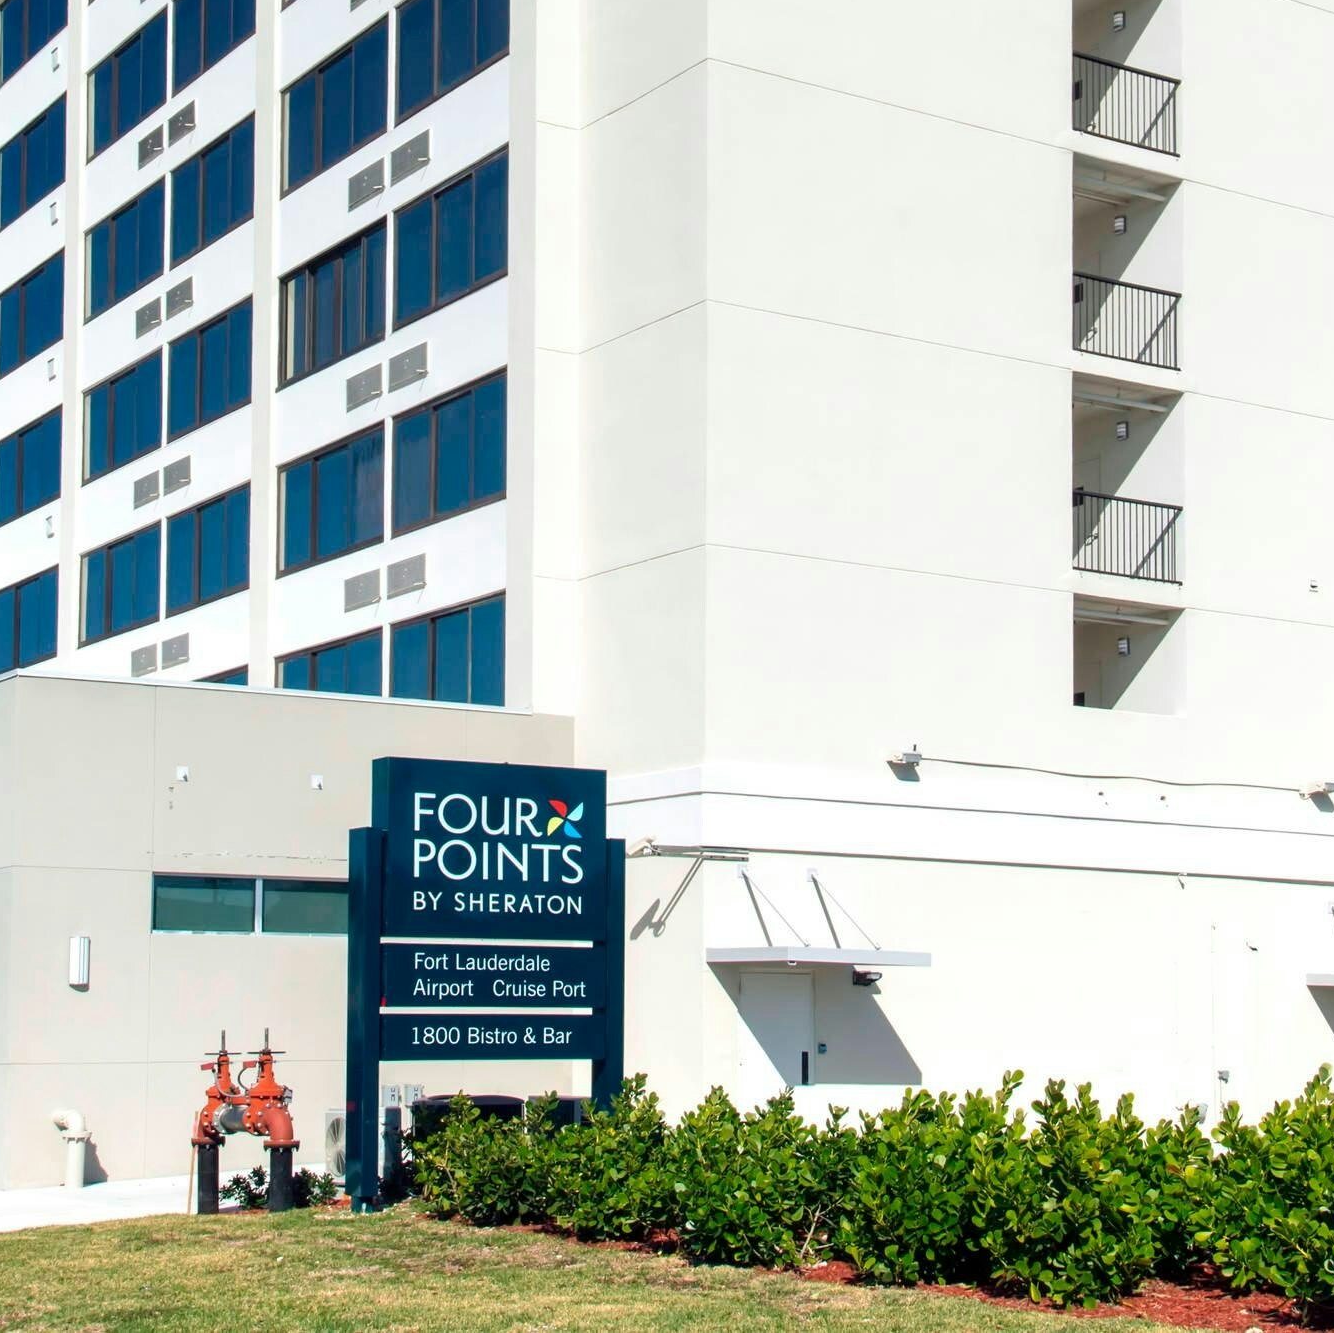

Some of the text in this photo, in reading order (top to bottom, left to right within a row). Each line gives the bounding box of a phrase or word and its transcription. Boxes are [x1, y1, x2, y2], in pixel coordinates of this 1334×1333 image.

[414, 792, 543, 837] FOUR
[414, 839, 584, 884] POINTS
[413, 891, 582, 915] BY SHERATON
[414, 952, 551, 971] Fort Lauderdale
[413, 978, 586, 1000] Airport Cruise Port
[411, 1027, 572, 1045] 1800 Bistro & Bar
